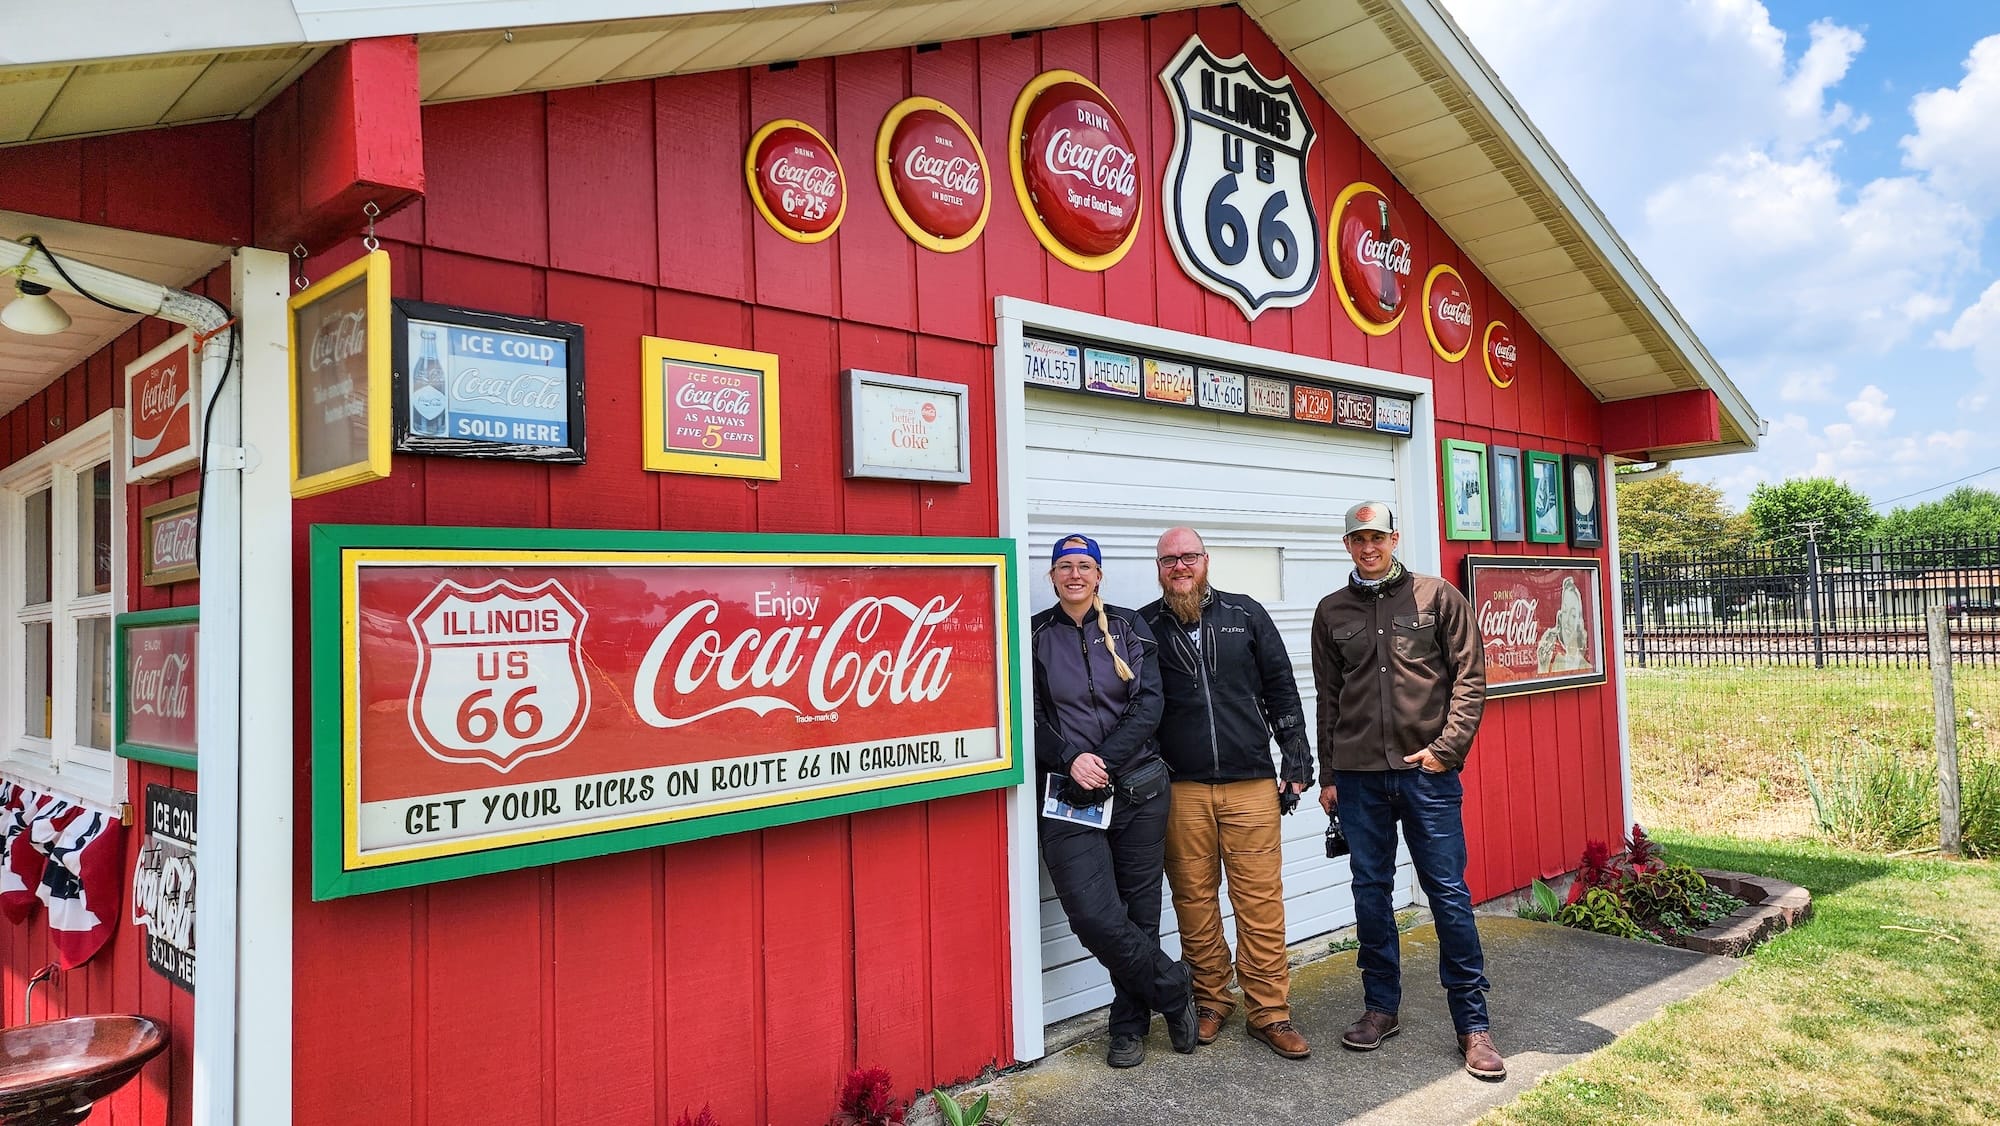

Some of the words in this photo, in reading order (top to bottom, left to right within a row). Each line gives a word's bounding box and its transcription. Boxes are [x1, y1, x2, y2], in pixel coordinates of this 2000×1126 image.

[1077, 107, 1110, 132] DRINK
[1201, 68, 1291, 142] ILLINOIS
[794, 147, 815, 159] DRINK
[934, 135, 954, 148] DRINK
[769, 157, 837, 198] Coca-Cola
[904, 145, 981, 196] Coca-Cola
[1045, 128, 1137, 197] Coca-Cola
[782, 189, 795, 212] 6
[939, 192, 963, 206] BOTTLES
[1067, 188, 1083, 208] Sign
[1083, 194, 1091, 207] of
[1091, 195, 1107, 213] Good
[1107, 200, 1123, 218] Taste
[1205, 172, 1299, 279] 66
[1357, 229, 1412, 276] Coca-Cola
[1437, 296, 1471, 327] Coca-Cola
[310, 307, 365, 372] Coca-Cola
[461, 333, 495, 354] ICE
[500, 341, 554, 361] COLD
[687, 371, 708, 383] ICE
[712, 375, 741, 387] COLD
[1024, 354, 1076, 382] 7AKL557
[1154, 371, 1192, 396] GRP244
[141, 364, 177, 421] Coca-Cola
[451, 368, 561, 410] Coca-Cola
[675, 382, 751, 415] Coca-Cola
[684, 412, 698, 422] AS
[704, 415, 745, 427] ALWAYS
[1309, 395, 1329, 415] 2349
[458, 418, 508, 438] SOLD
[513, 422, 561, 442] HERE
[676, 427, 702, 437] FIVE
[701, 424, 724, 449] 5
[723, 431, 754, 442] CENTS
[891, 428, 929, 450] Coke
[903, 419, 926, 435] with
[154, 517, 198, 565] Coca-Cola
[753, 589, 820, 621] Enjoy
[1493, 590, 1514, 600] DRINK
[442, 609, 560, 636] ILLINOIS
[1477, 598, 1539, 648] Coca-Cola
[476, 650, 530, 681] US
[633, 594, 964, 729] Coca-Cola
[131, 653, 190, 719] Coca-Cola
[456, 686, 543, 743] 66
[404, 798, 466, 835] GET
[483, 787, 561, 825] YOUR
[575, 774, 655, 811] KICKS
[666, 768, 699, 798] ON
[712, 757, 788, 792] ROUTE
[797, 753, 822, 780] 66
[830, 749, 851, 776] IN
[859, 740, 947, 772] GARDNER,
[954, 736, 969, 760] IL
[152, 800, 170, 833] ICE
[172, 807, 197, 841] COL
[151, 940, 176, 973] SOLD
[178, 952, 196, 984] HE
